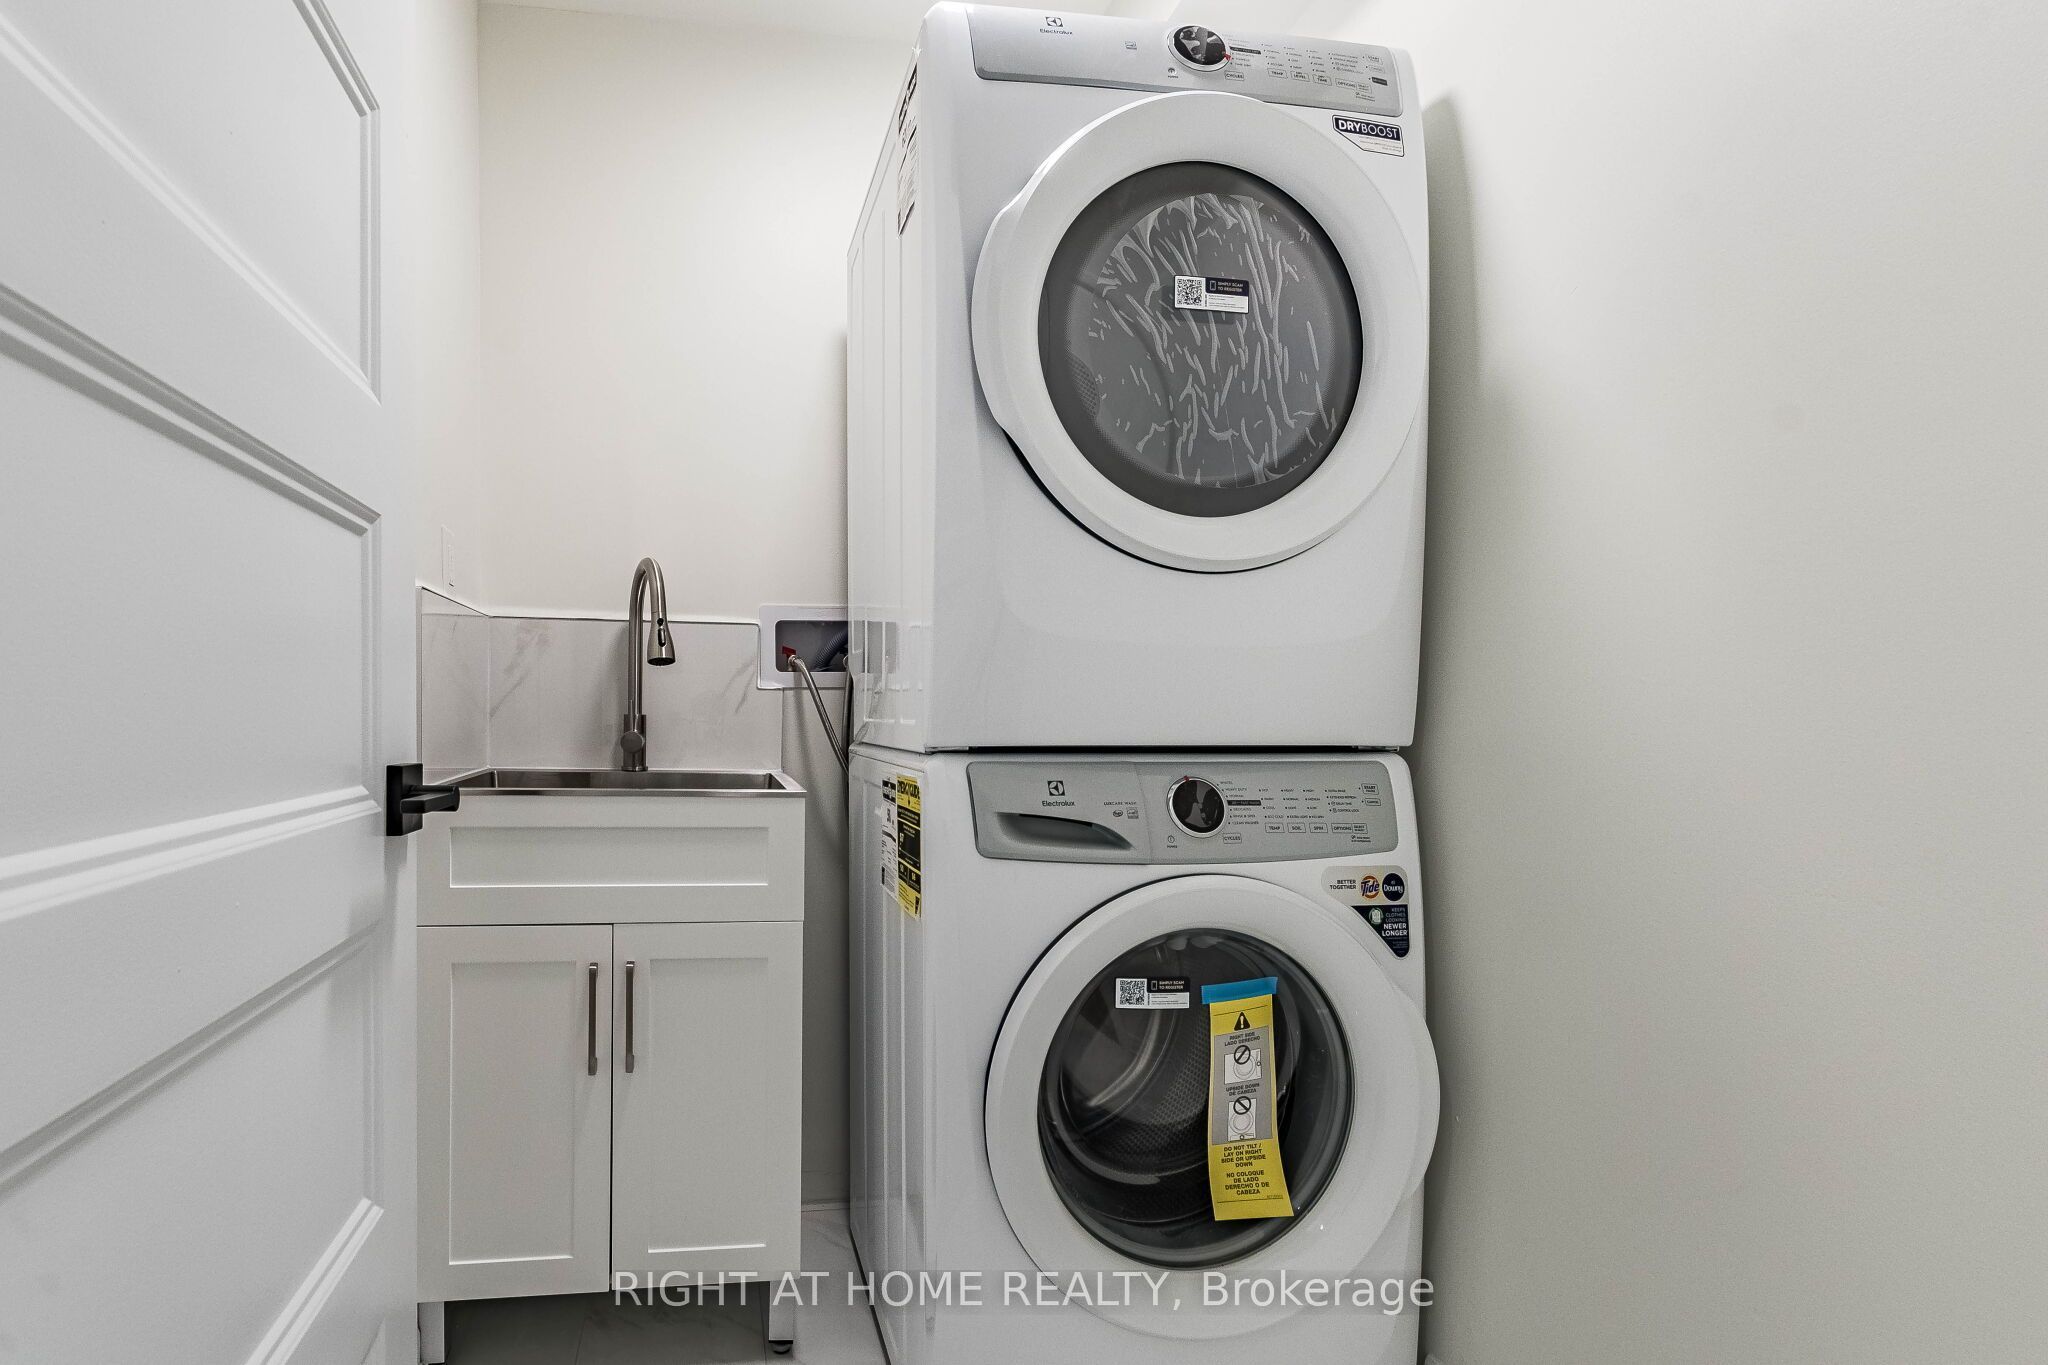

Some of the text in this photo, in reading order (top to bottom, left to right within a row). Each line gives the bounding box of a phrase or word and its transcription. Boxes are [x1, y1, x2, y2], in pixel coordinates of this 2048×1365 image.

[1338, 119, 1398, 138] DRYBOOST
[1360, 880, 1380, 897] Tide
[1383, 884, 1404, 893] Downy
[1383, 922, 1407, 930] NEWER
[1381, 929, 1408, 937] LONGER
[1238, 1035, 1260, 1044] DERECHO
[1236, 1169, 1264, 1177] COLOQUE
